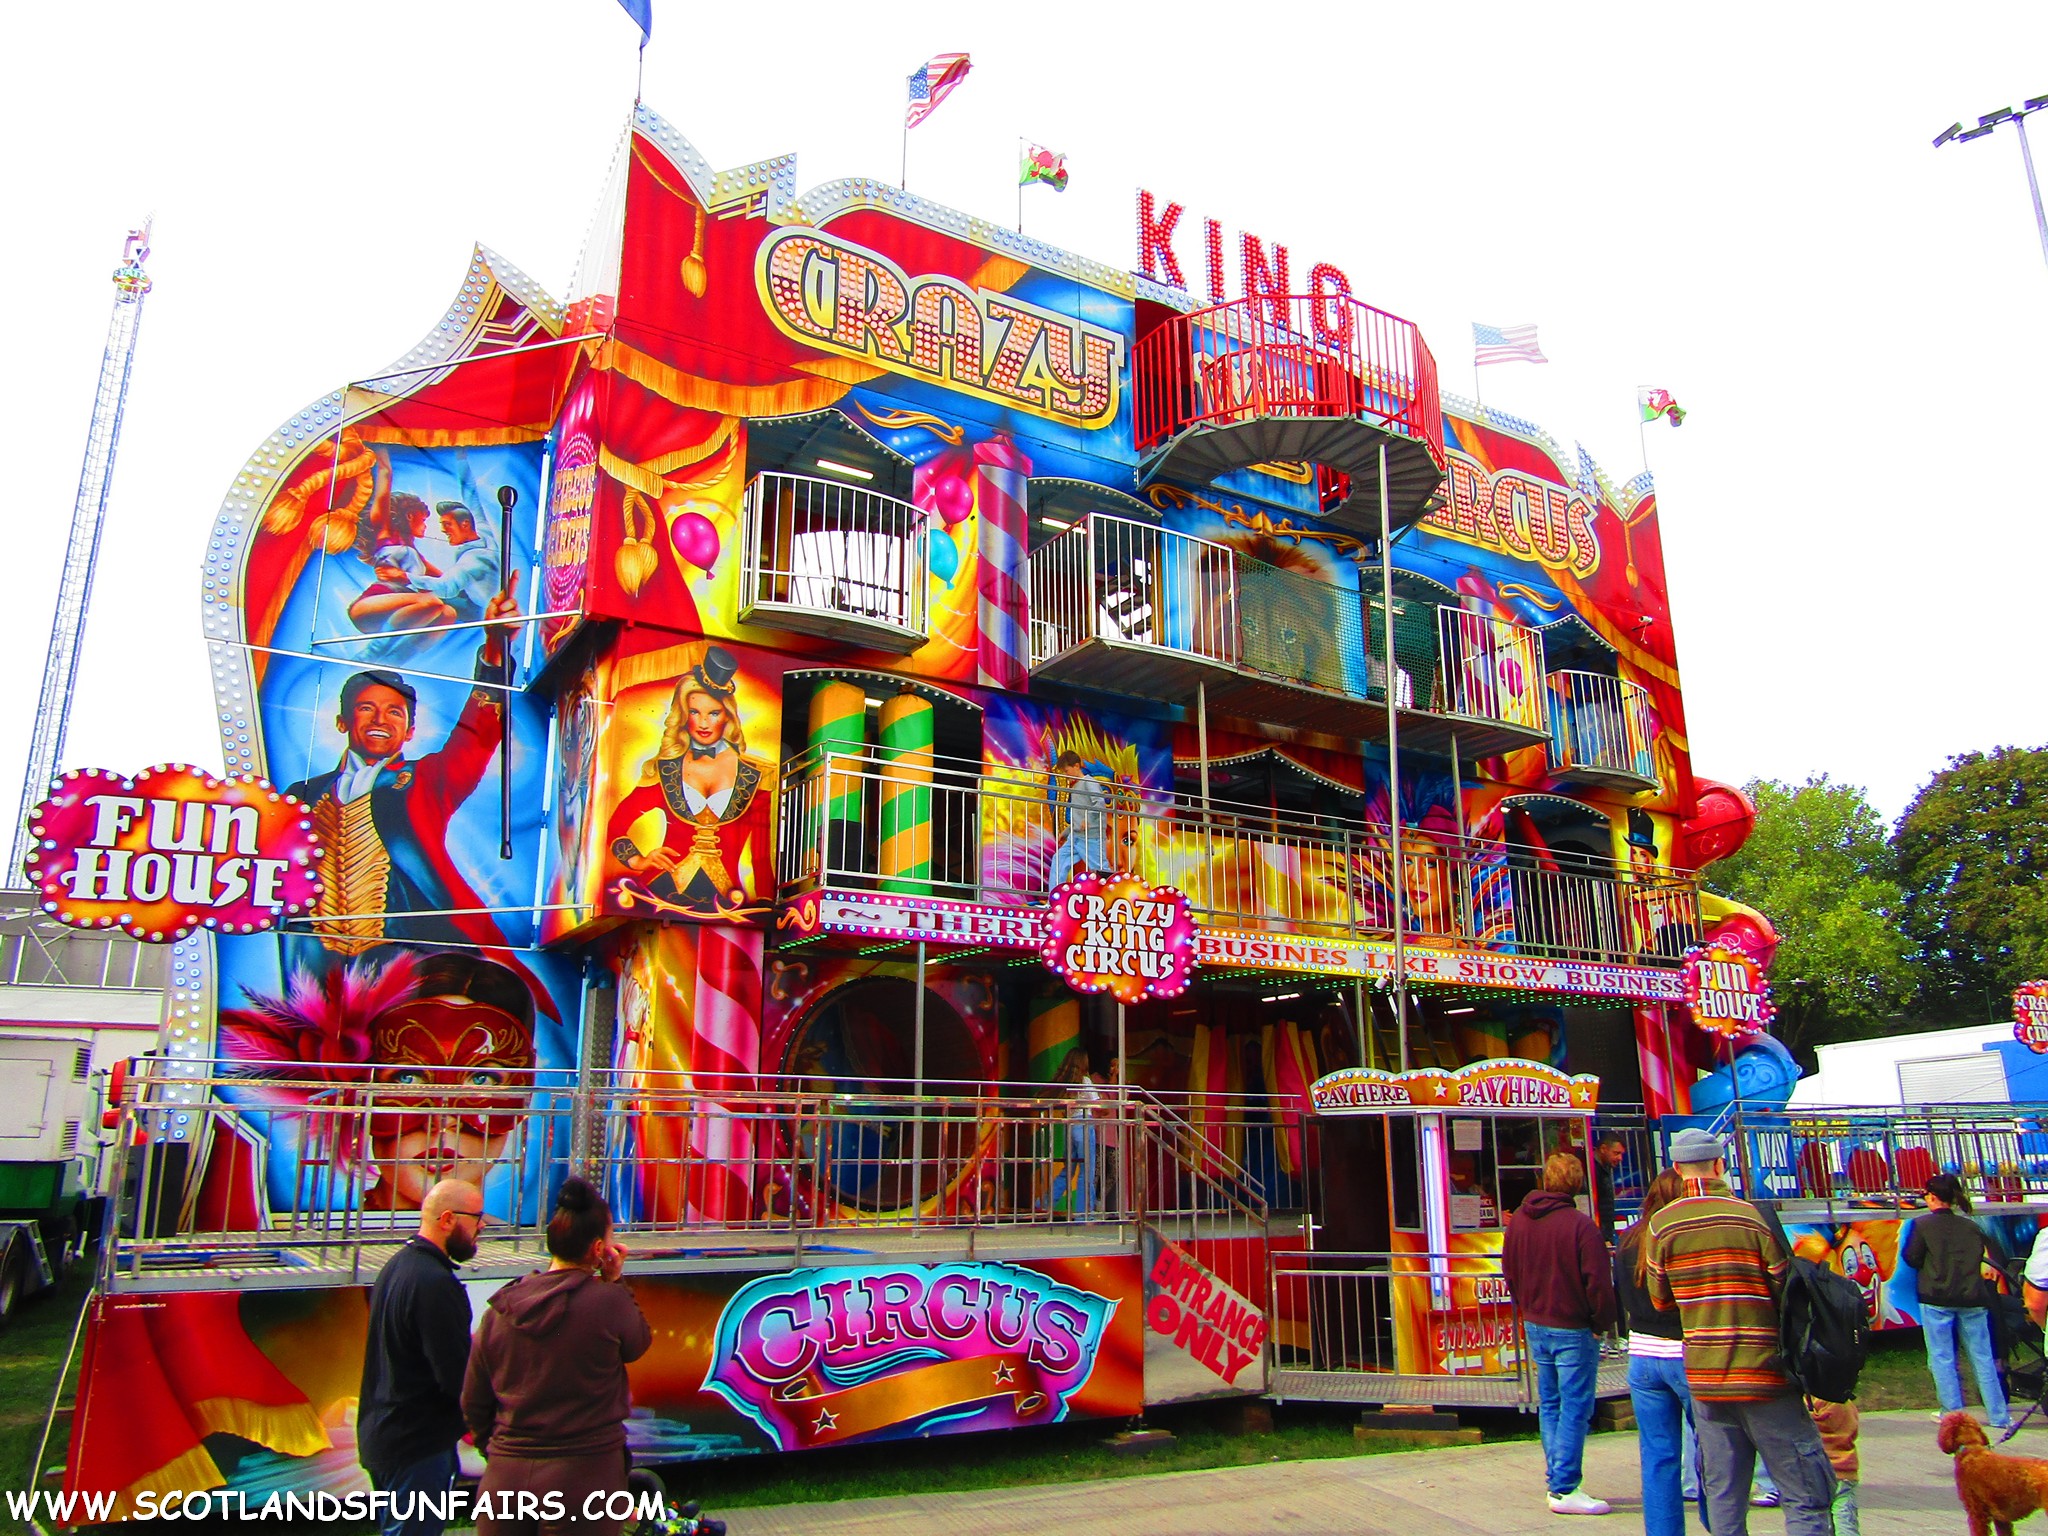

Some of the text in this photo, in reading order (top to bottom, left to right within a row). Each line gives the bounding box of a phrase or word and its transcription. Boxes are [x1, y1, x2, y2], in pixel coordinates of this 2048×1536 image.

[1136, 187, 1354, 350] KING
[769, 235, 1115, 418] CRAZY
[83, 795, 259, 854] FUN
[60, 848, 289, 907] HOUSE
[1067, 894, 1175, 928] CRAZY
[1081, 920, 1165, 952] KING
[1065, 945, 1175, 980] CIRCUS
[1198, 937, 1685, 994] BUSINES LIKE SHOW BUSINESS
[1695, 960, 1749, 992] FUN
[1697, 989, 1761, 1022] HOUSE
[1317, 1083, 1410, 1107] PAY HERE
[1457, 1075, 1571, 1107] PAY HERE
[1150, 1247, 1270, 1356] ENTRANCE
[734, 1273, 1090, 1384] CIRCUS
[1147, 1294, 1254, 1385] ONLY
[1436, 1317, 1513, 1350] ENTRANCE
